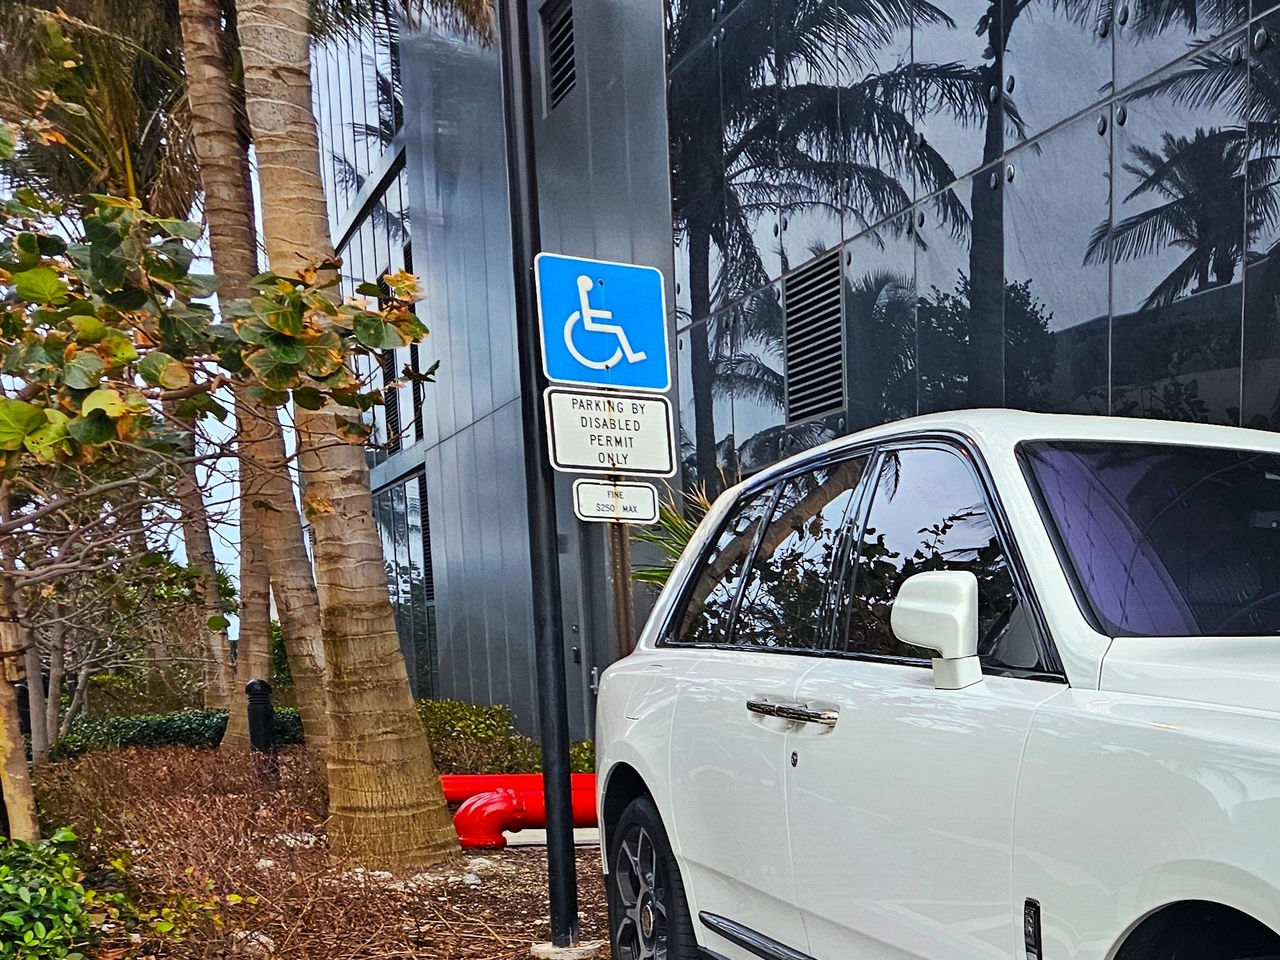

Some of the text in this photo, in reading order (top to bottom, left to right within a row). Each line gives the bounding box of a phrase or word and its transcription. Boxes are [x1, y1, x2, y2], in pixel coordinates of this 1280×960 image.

[572, 398, 645, 414] PARKING BY
[581, 416, 640, 431] DISABLED
[590, 434, 634, 448] PERMIT
[598, 452, 628, 465] ONLY
[607, 490, 624, 499] FINE
[596, 503, 638, 513] $250 MAX
